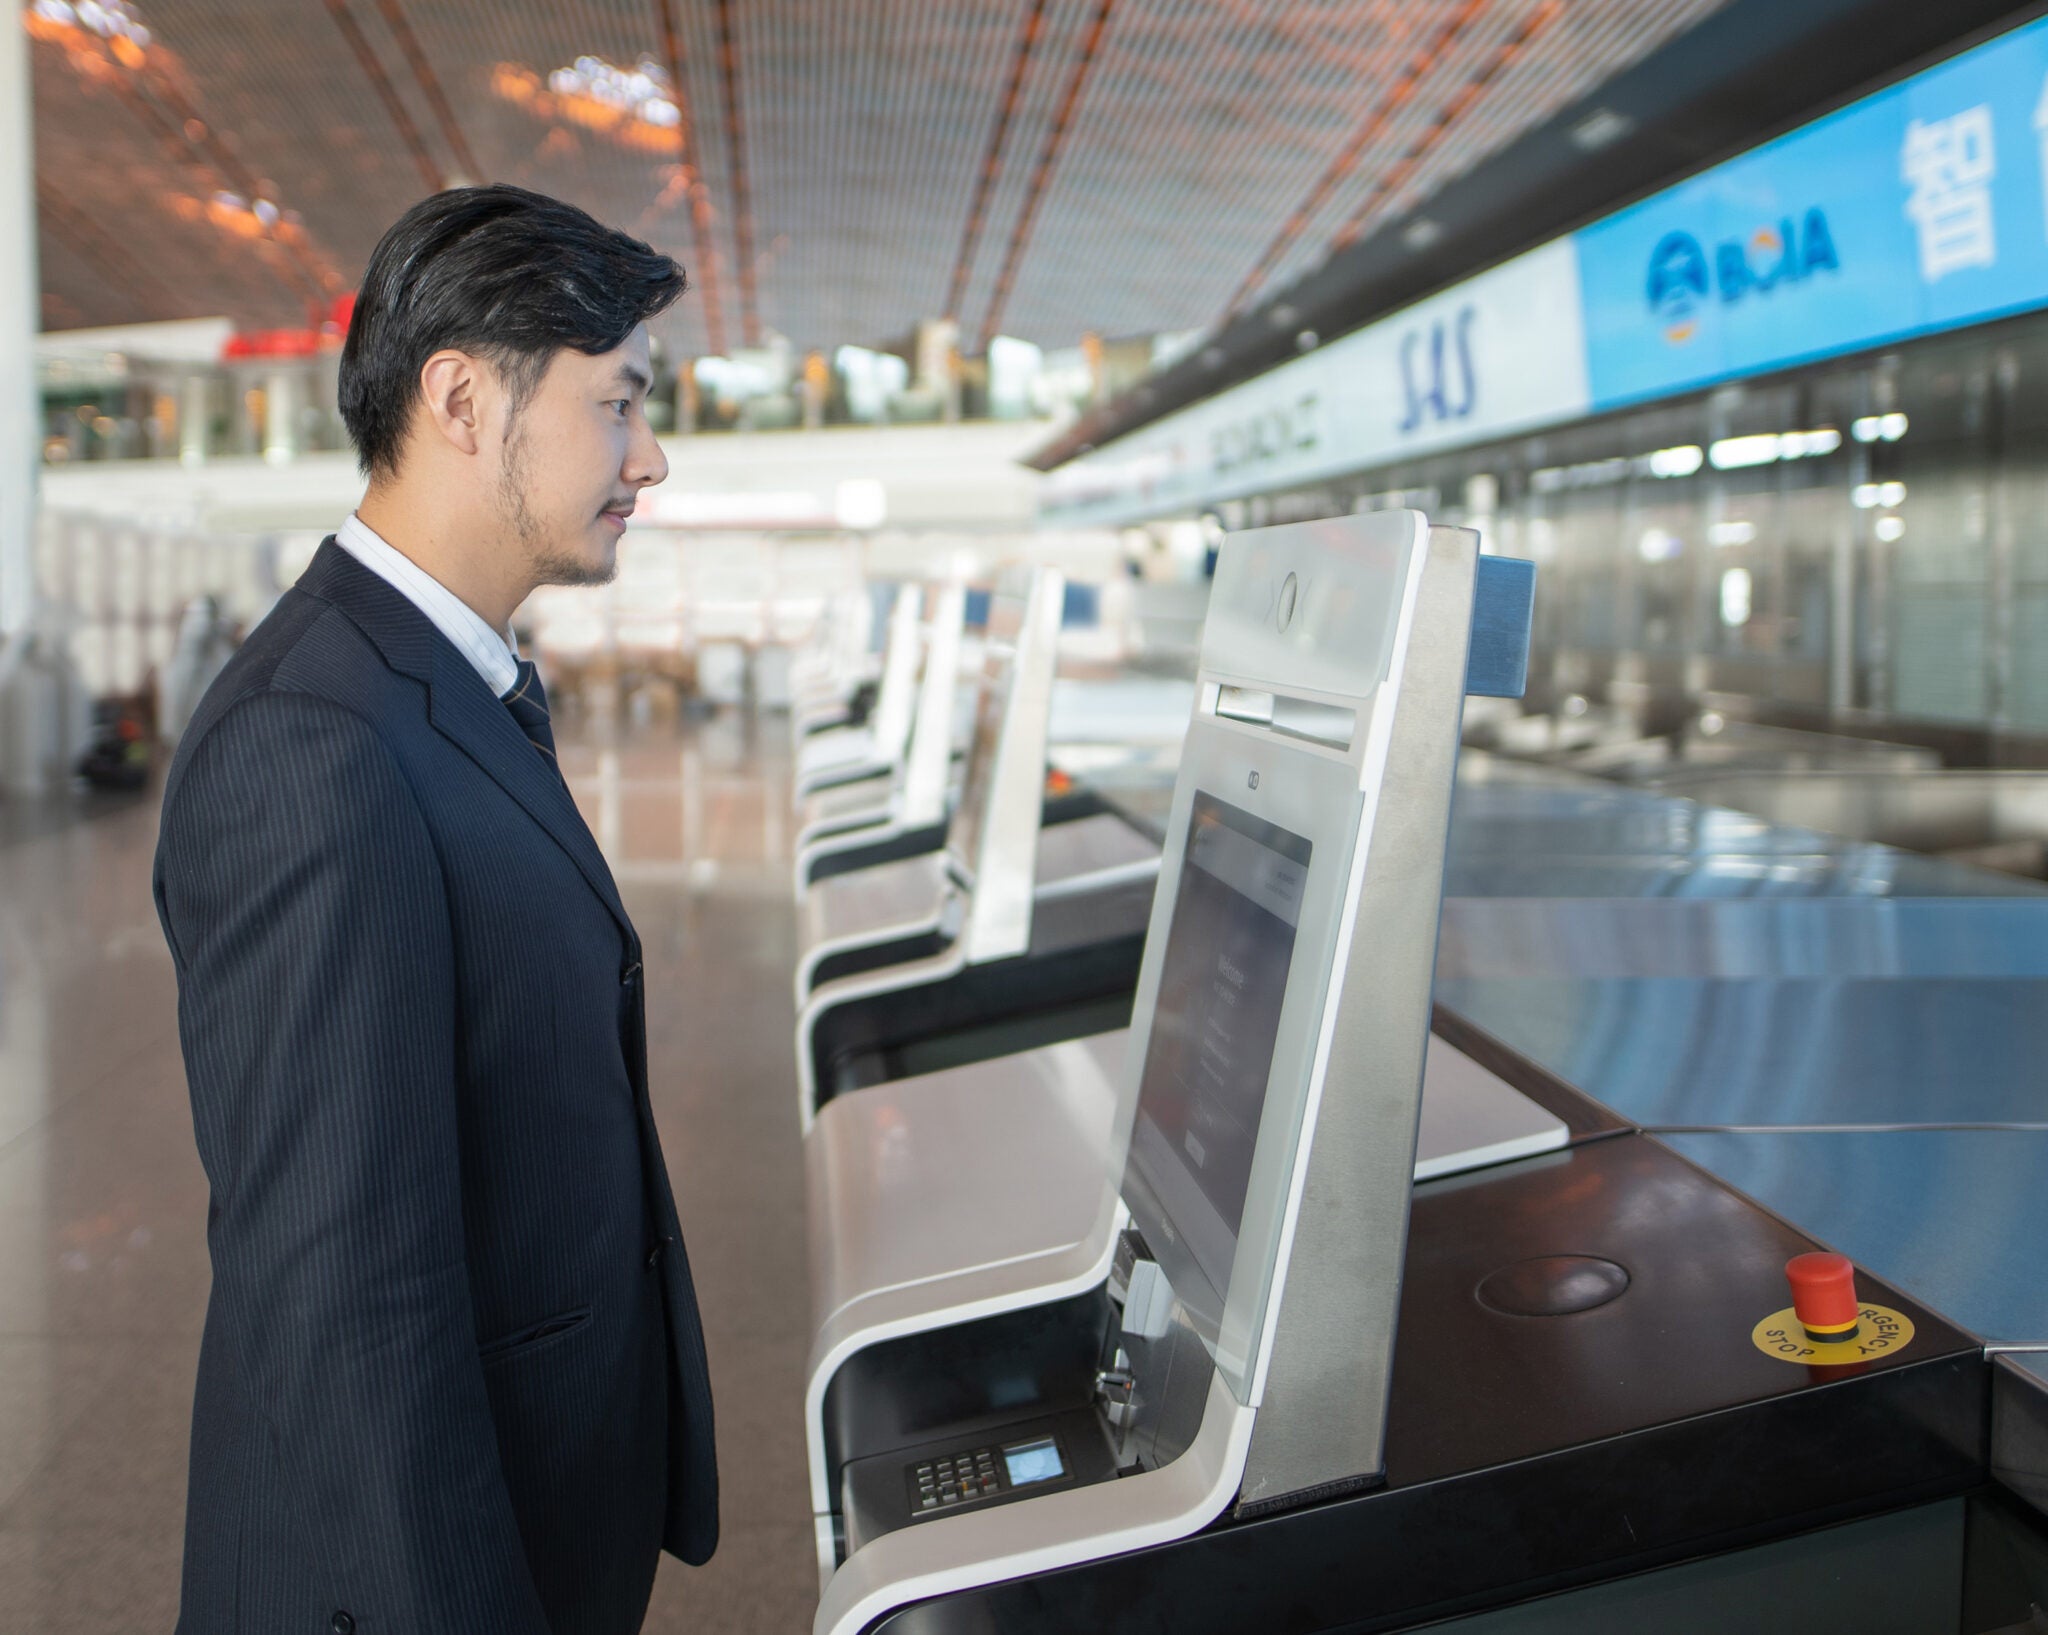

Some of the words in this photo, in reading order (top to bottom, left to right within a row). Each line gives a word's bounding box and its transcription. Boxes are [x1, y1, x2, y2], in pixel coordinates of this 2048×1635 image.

[1399, 305, 1475, 432] SAS
[1766, 1329, 1815, 1357] STOP
[1858, 1307, 1900, 1355] RGENCY
